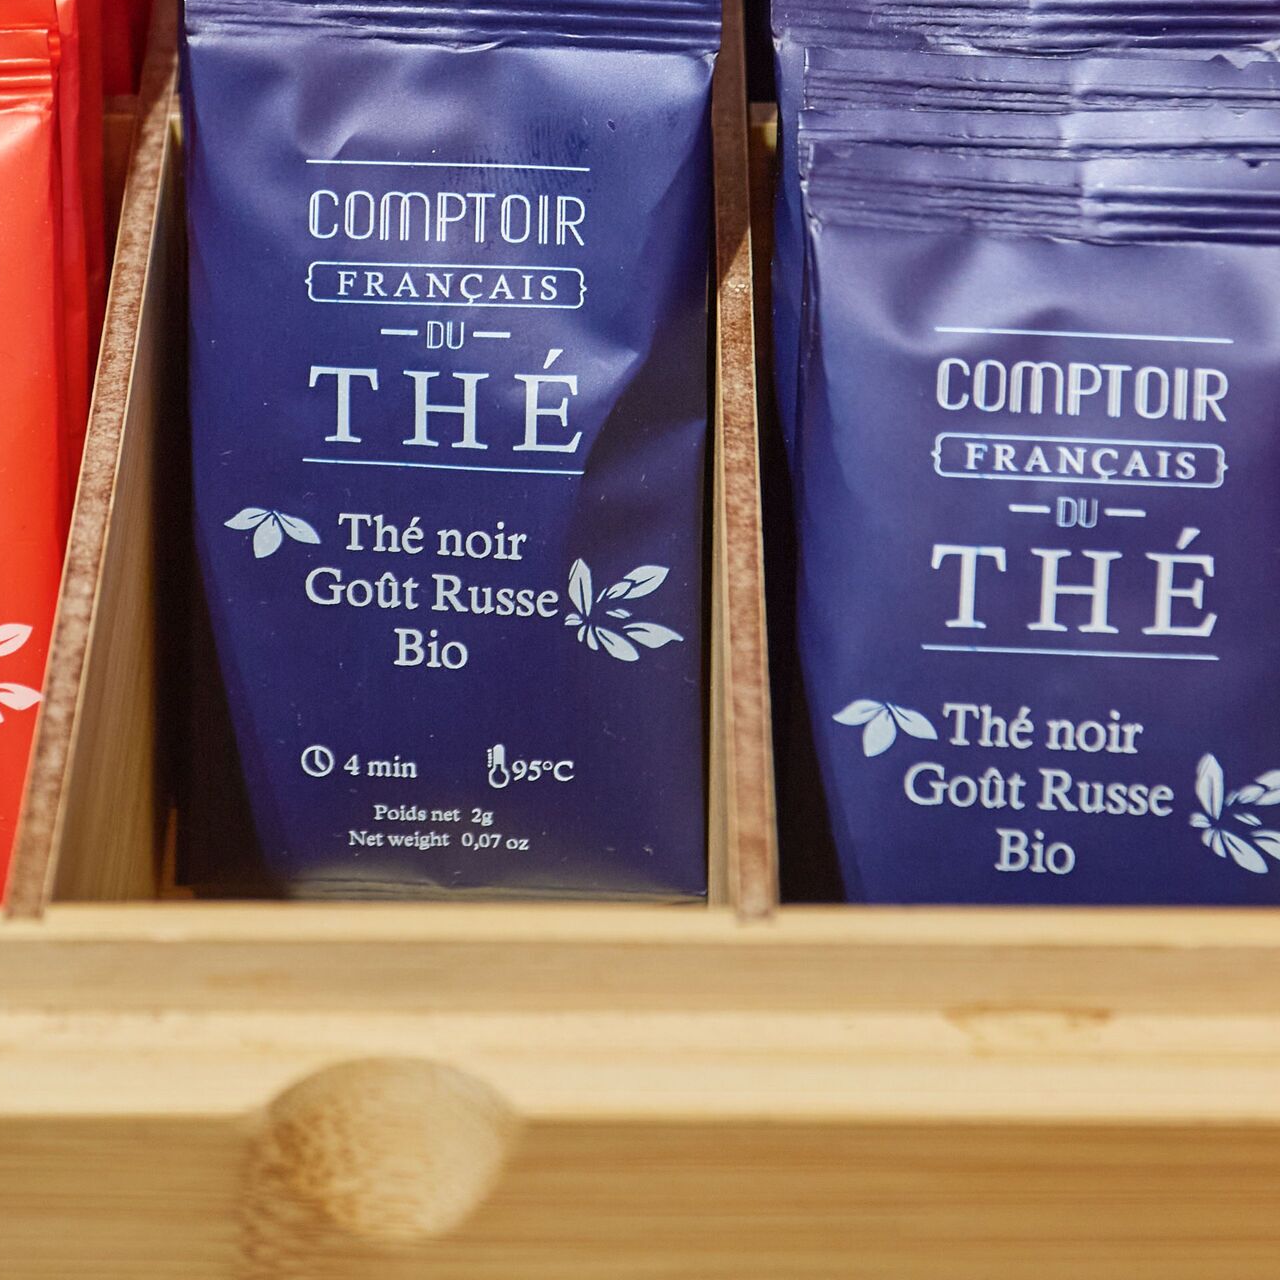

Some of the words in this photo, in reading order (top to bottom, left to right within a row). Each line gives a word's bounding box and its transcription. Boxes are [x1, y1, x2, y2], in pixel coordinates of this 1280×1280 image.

[307, 188, 587, 247] COMPTOIR
[337, 270, 560, 306] FRANÇAIS
[425, 320, 466, 350] DU
[308, 348, 585, 455] THÉ
[936, 357, 1228, 423] COMPTOIR
[964, 442, 1198, 483] FRANÇAIS
[338, 512, 426, 554] Thé
[436, 521, 527, 561] noir
[1056, 497, 1099, 529] DU
[304, 567, 420, 612] Goût
[431, 576, 560, 619] Russe
[931, 527, 1219, 637] THÉ
[393, 628, 469, 671] Bio
[942, 703, 1034, 750] Thé
[1046, 711, 1143, 754] noir
[343, 754, 360, 776] 4
[367, 754, 418, 779] min
[511, 759, 575, 782] 95°C
[904, 762, 1026, 810] Goût
[1036, 770, 1174, 815] Russe
[373, 804, 427, 822] Poids
[431, 808, 461, 823] net
[471, 808, 494, 826] 2g
[348, 830, 384, 847] Net
[387, 831, 450, 850] weight
[461, 833, 502, 852] 0,07
[506, 838, 529, 851] oz
[995, 828, 1075, 875] Bio
